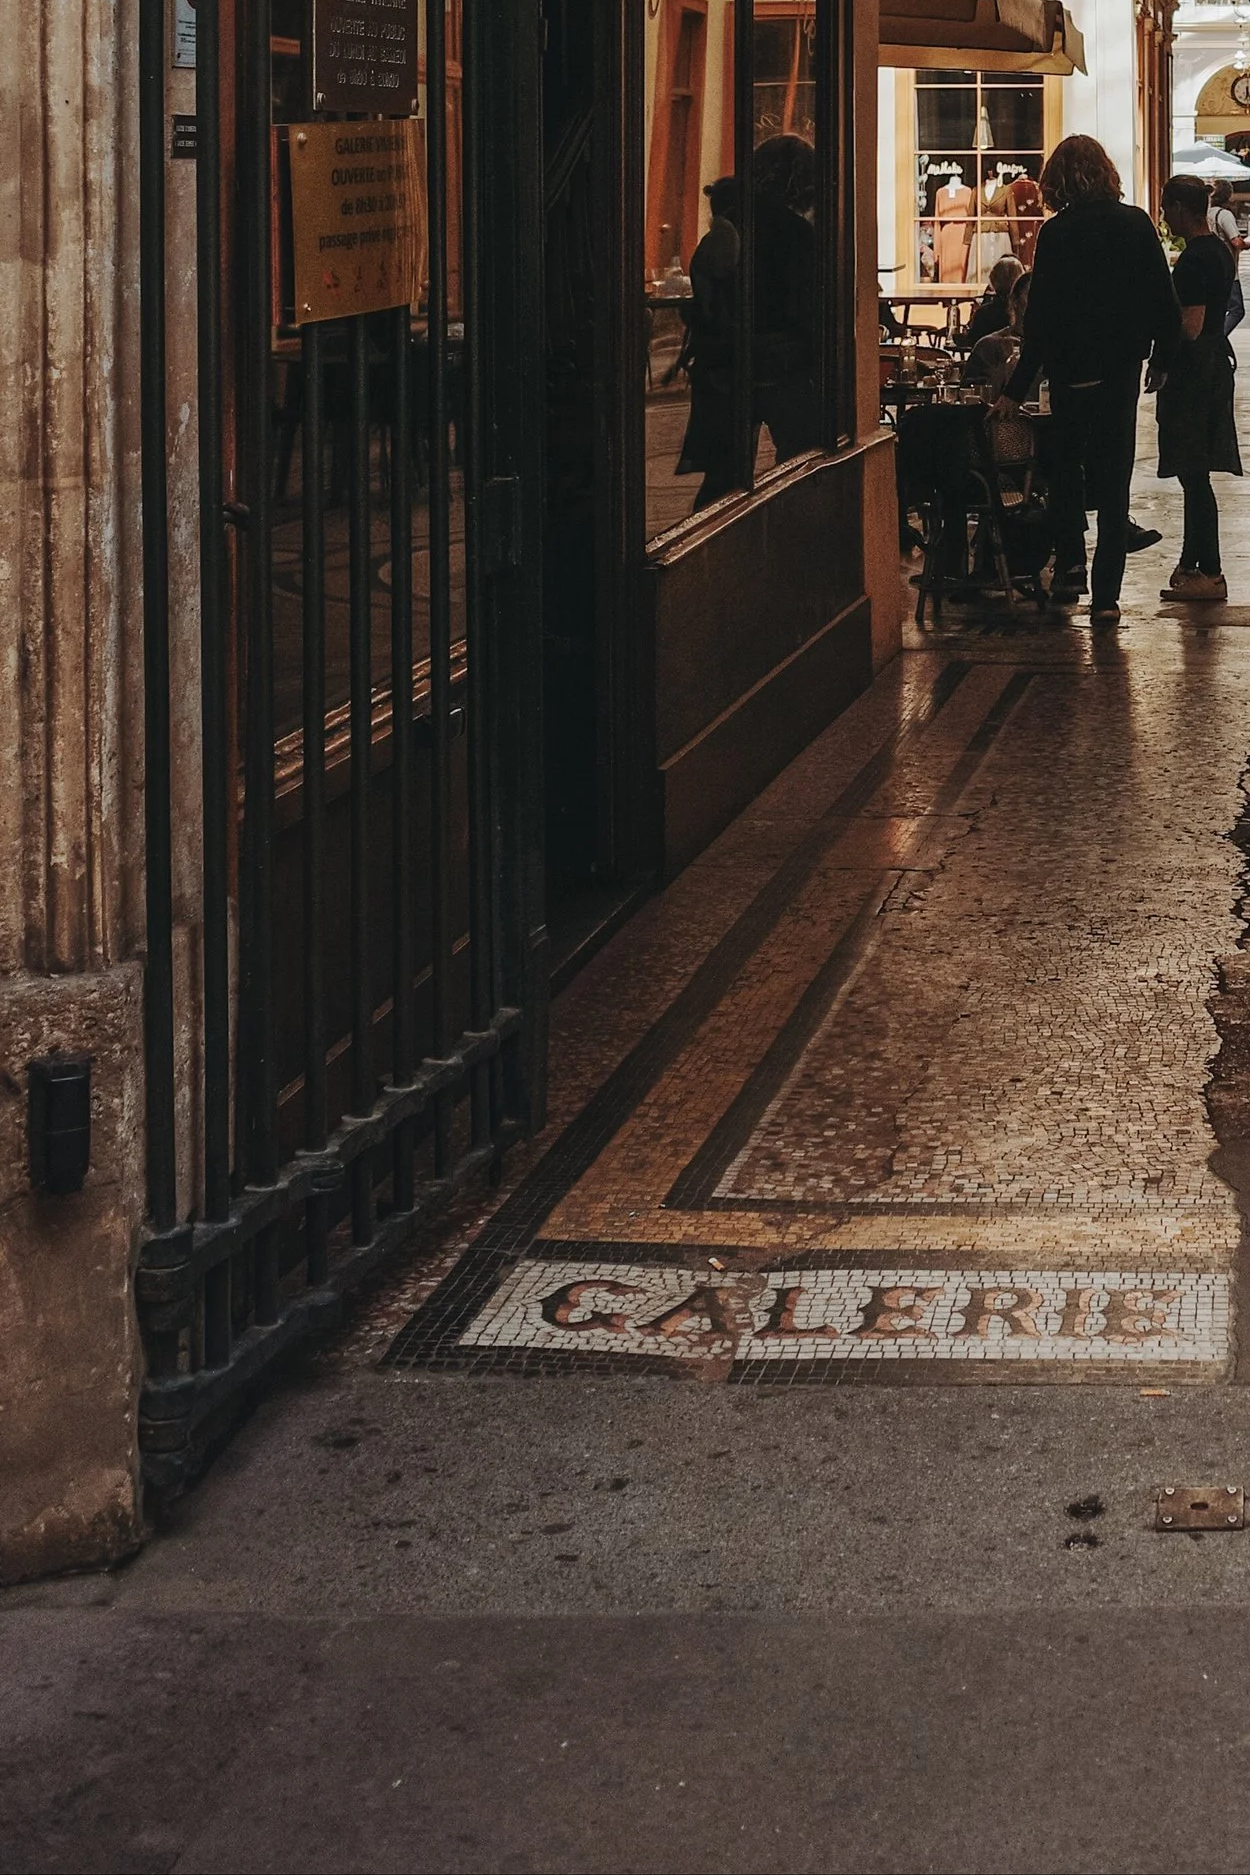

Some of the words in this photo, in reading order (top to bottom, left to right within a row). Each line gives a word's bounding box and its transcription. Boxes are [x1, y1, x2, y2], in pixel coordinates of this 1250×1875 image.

[330, 16, 365, 36] OUVERTE
[335, 136, 374, 155] GALERIE
[331, 168, 374, 186] OUVERTE
[341, 197, 354, 215] de
[319, 232, 358, 253] passage
[539, 1278, 1192, 1344] GALERIE
